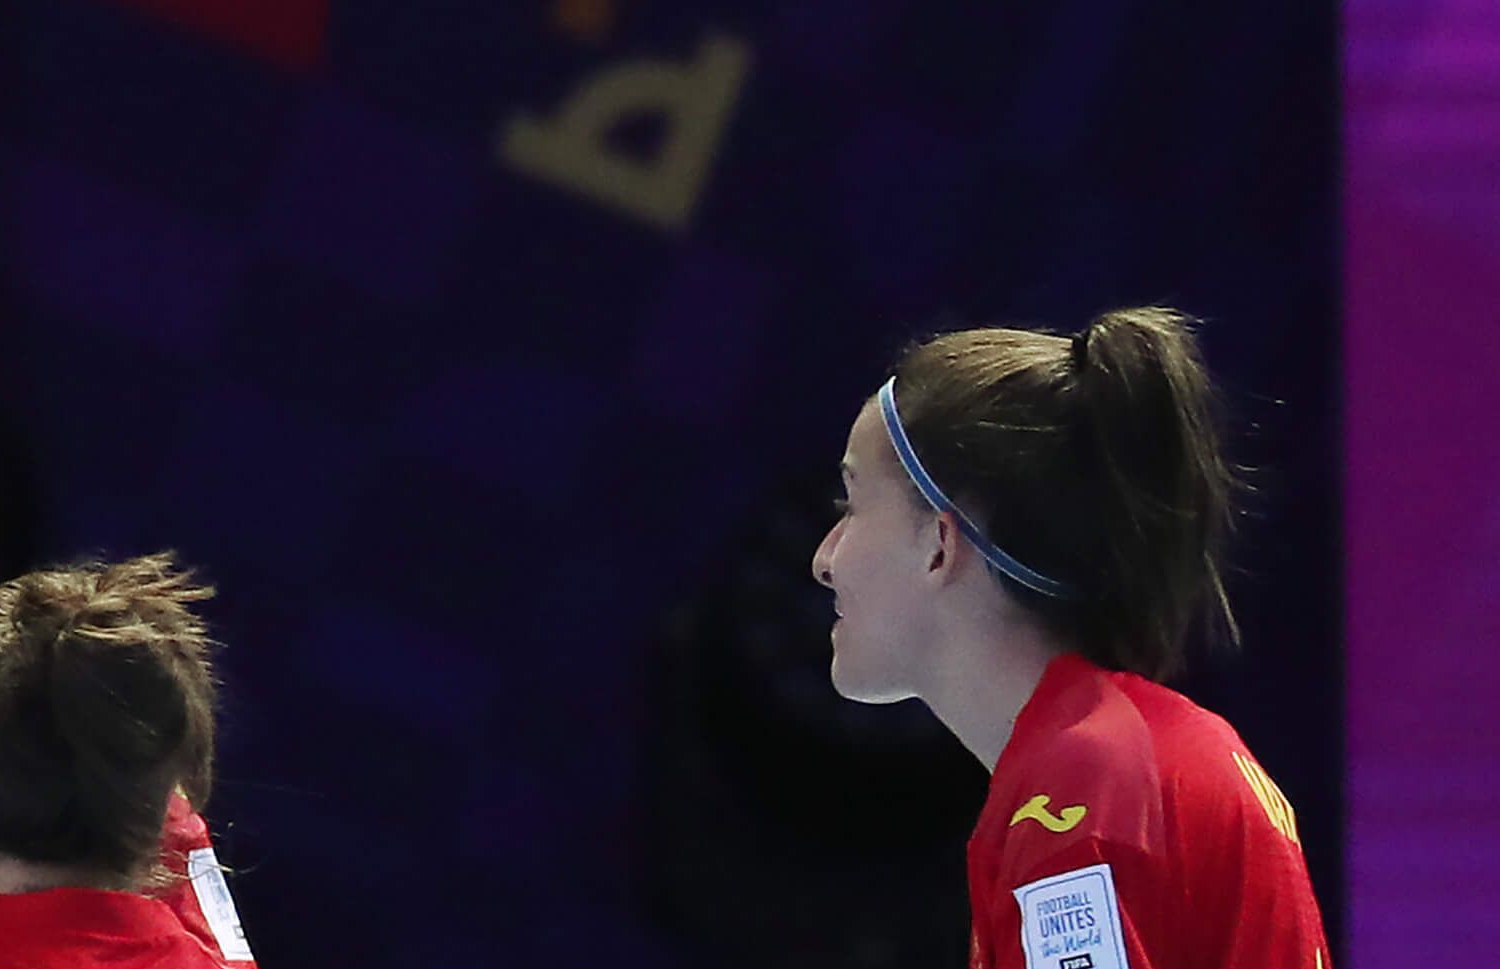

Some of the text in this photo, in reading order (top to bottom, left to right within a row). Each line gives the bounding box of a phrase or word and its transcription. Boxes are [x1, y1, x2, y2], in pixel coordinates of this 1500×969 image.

[1036, 891, 1092, 916] FOOTBALL
[1039, 907, 1096, 938] UNITES
[1041, 928, 1102, 958] the World
